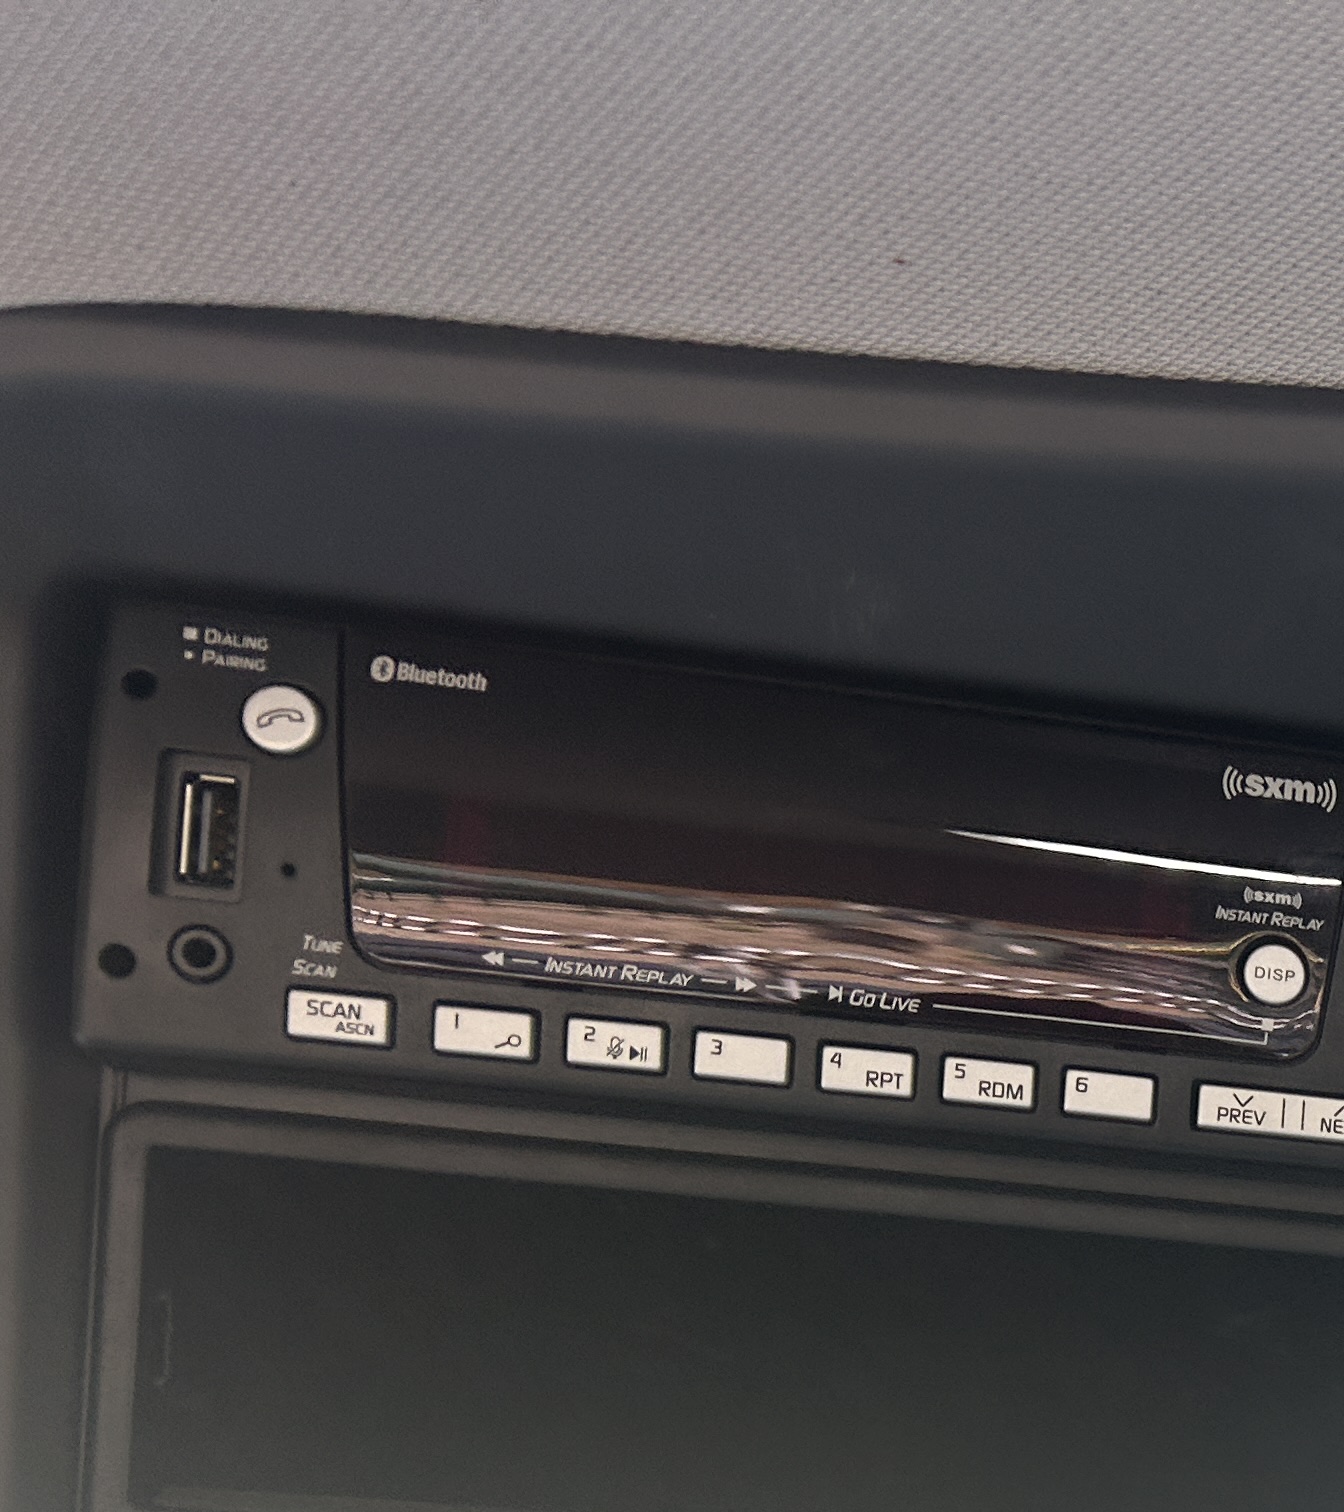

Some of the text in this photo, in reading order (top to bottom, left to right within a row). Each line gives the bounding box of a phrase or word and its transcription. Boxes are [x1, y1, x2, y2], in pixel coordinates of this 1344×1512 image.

[203, 627, 269, 652] DIALING
[201, 650, 267, 672] PAIRING
[395, 660, 489, 693] Bluetooth
[1214, 904, 1325, 932] INSTANT REPLAY
[303, 934, 344, 955] TUNE
[291, 958, 339, 979] SCAN
[544, 956, 694, 988] INSTANT REPLAY
[1254, 965, 1297, 983] DISP
[306, 999, 361, 1020] SCAN
[335, 1020, 375, 1037] ASCN
[583, 1025, 596, 1042] 2
[710, 1039, 723, 1056] 3
[829, 1052, 842, 1069] 4
[865, 1070, 904, 1090] RPT
[954, 1063, 966, 1079] 5
[978, 1080, 1024, 1100] RDM
[1075, 1076, 1089, 1093] 6
[1216, 1106, 1267, 1126] PREV
